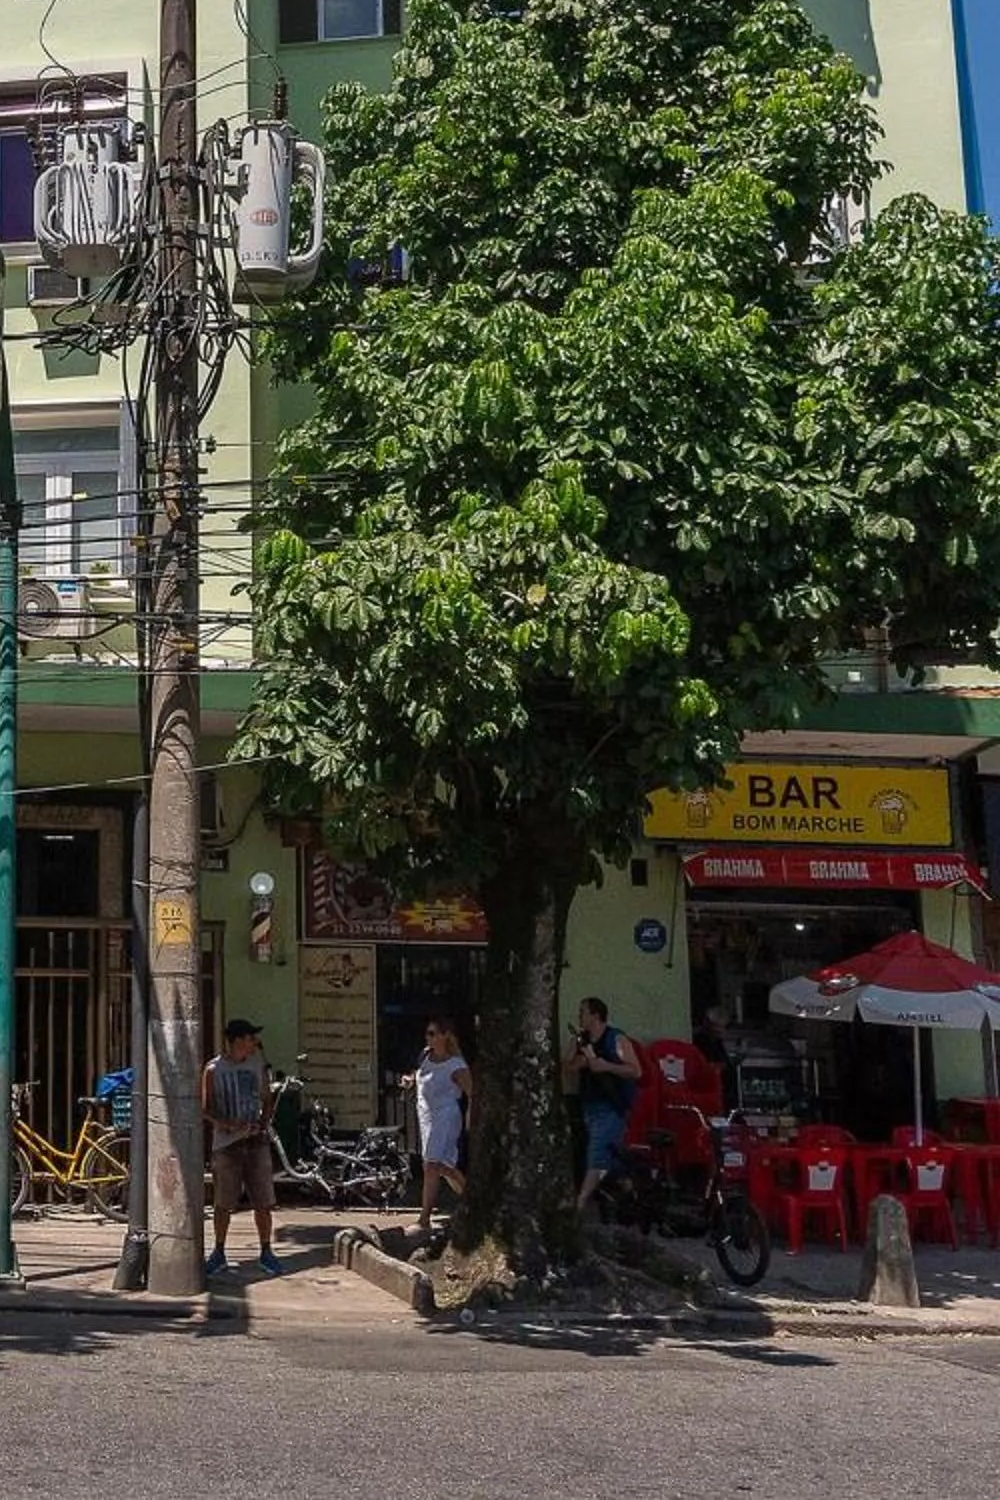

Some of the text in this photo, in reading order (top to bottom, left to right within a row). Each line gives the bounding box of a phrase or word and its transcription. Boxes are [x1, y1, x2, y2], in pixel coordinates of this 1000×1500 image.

[748, 775, 841, 810] BAR
[732, 814, 865, 833] BOM MARCHE
[703, 858, 765, 879] BRAHMA
[809, 860, 870, 881] BRAHMA
